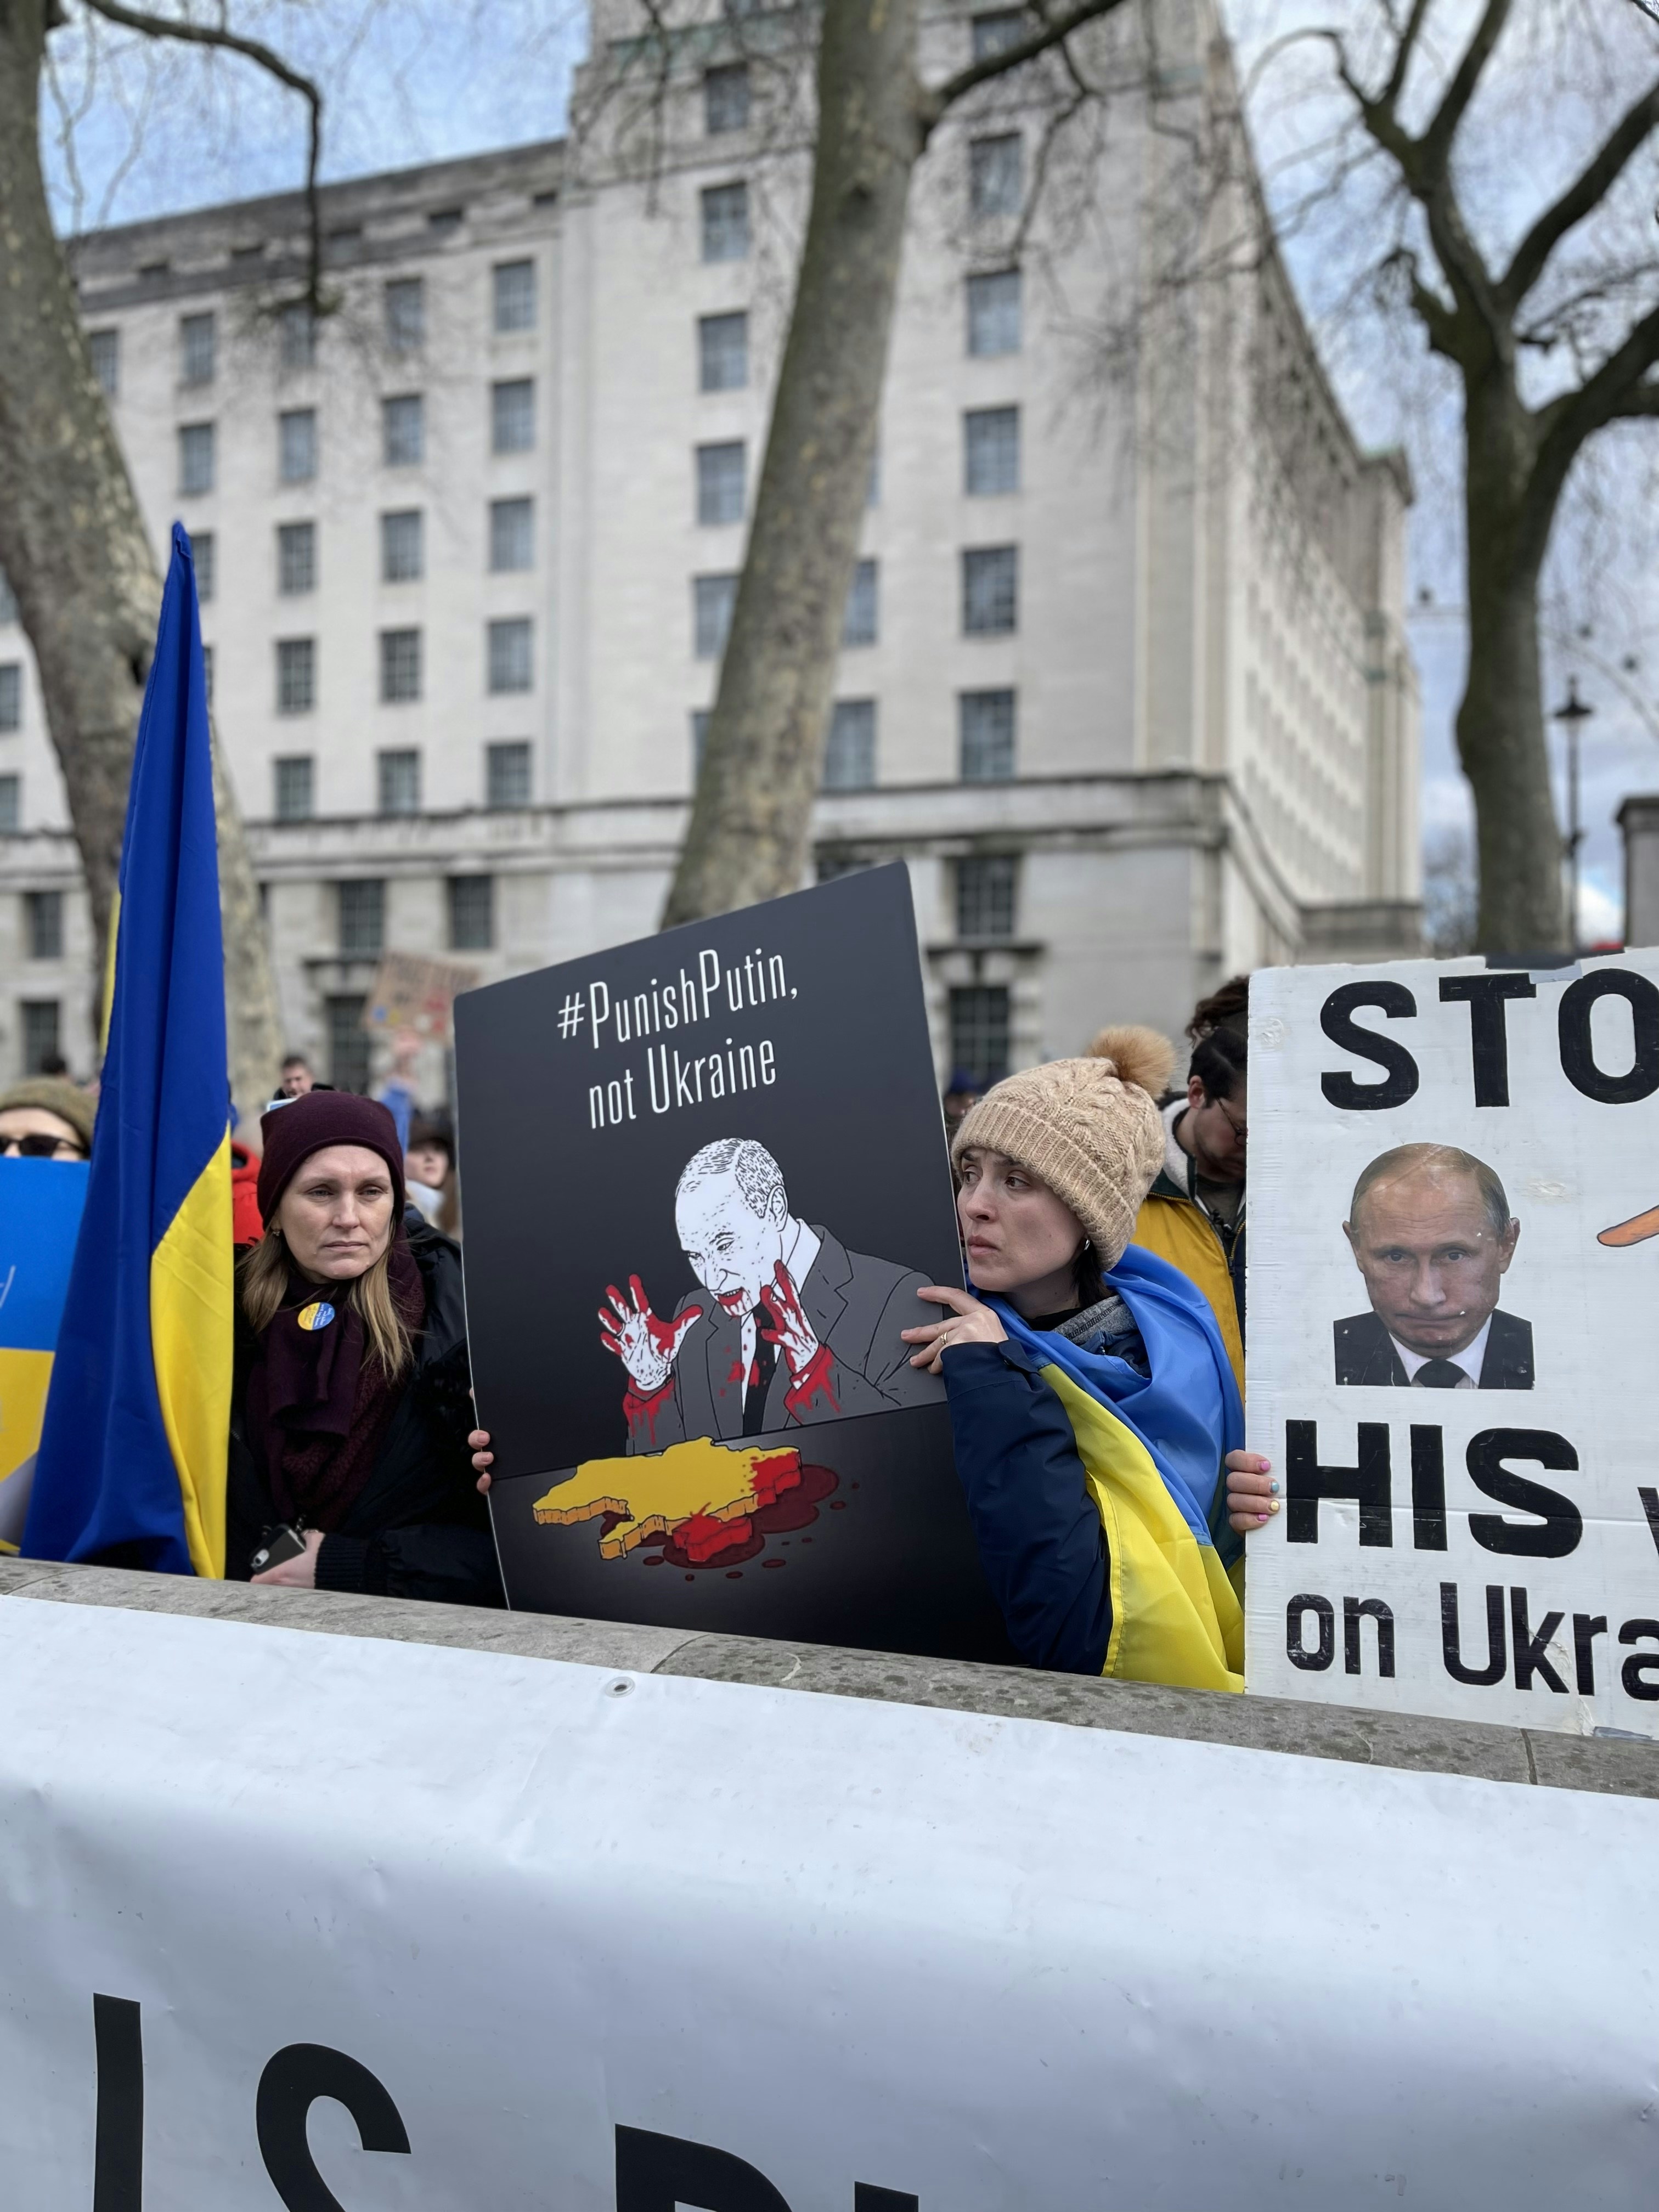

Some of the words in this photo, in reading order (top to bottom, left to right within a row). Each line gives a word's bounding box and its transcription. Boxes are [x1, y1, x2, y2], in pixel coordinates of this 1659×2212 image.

[557, 948, 798, 1049] #PunishPutin,
[1319, 968, 1659, 1111] STO
[589, 1069, 636, 1129] not
[647, 1037, 776, 1113] Ukraine
[1285, 1419, 1583, 1559] HIS
[1286, 1593, 1395, 1678] on
[1440, 1582, 1659, 1702] Ukra
